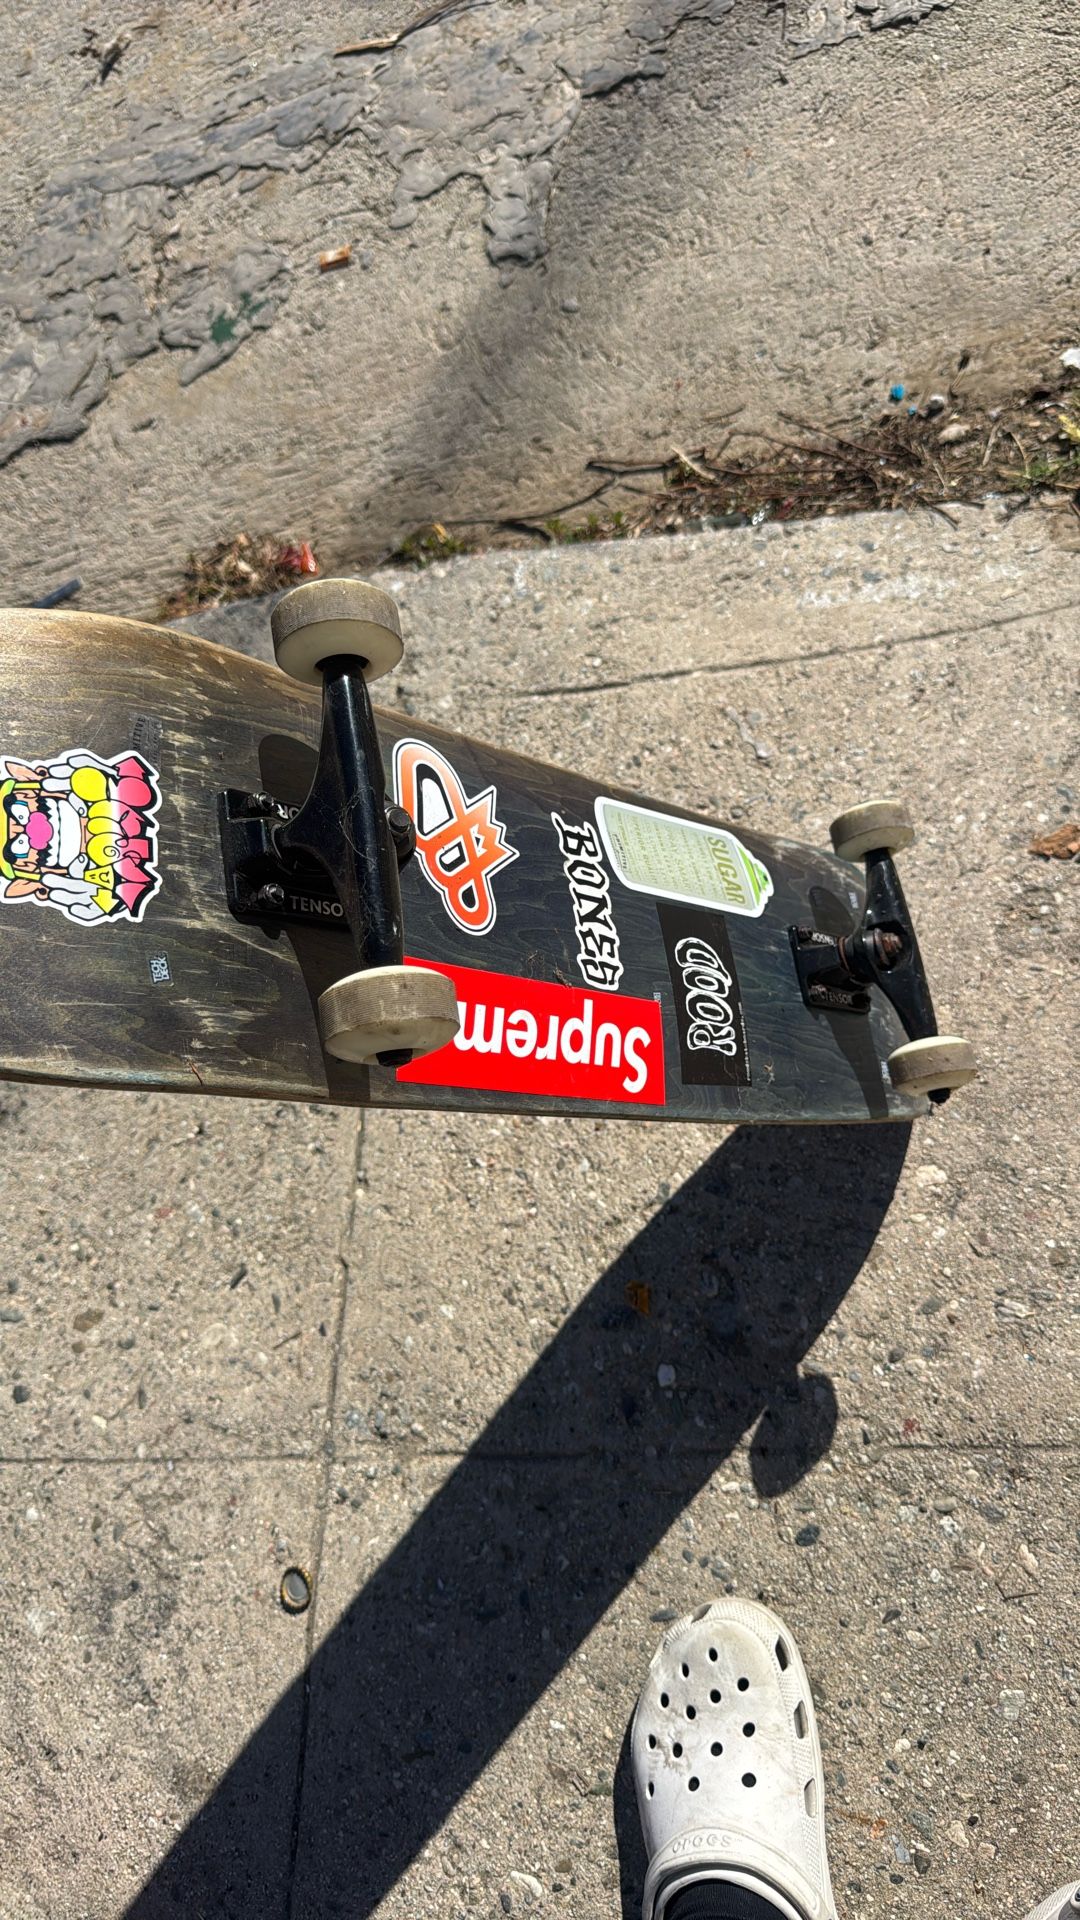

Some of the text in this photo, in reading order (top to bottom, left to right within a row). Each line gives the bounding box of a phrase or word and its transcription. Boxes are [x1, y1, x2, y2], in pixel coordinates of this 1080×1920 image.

[132, 717, 146, 751] MITIVE
[707, 835, 746, 906] SUGAR
[290, 895, 345, 918] TENSO
[552, 812, 623, 990] BONES
[150, 960, 163, 983] TECH
[158, 956, 170, 980] DECK
[674, 936, 738, 1057] ROOD
[454, 998, 652, 1094] Suprem
[672, 1833, 734, 1854] crocs
